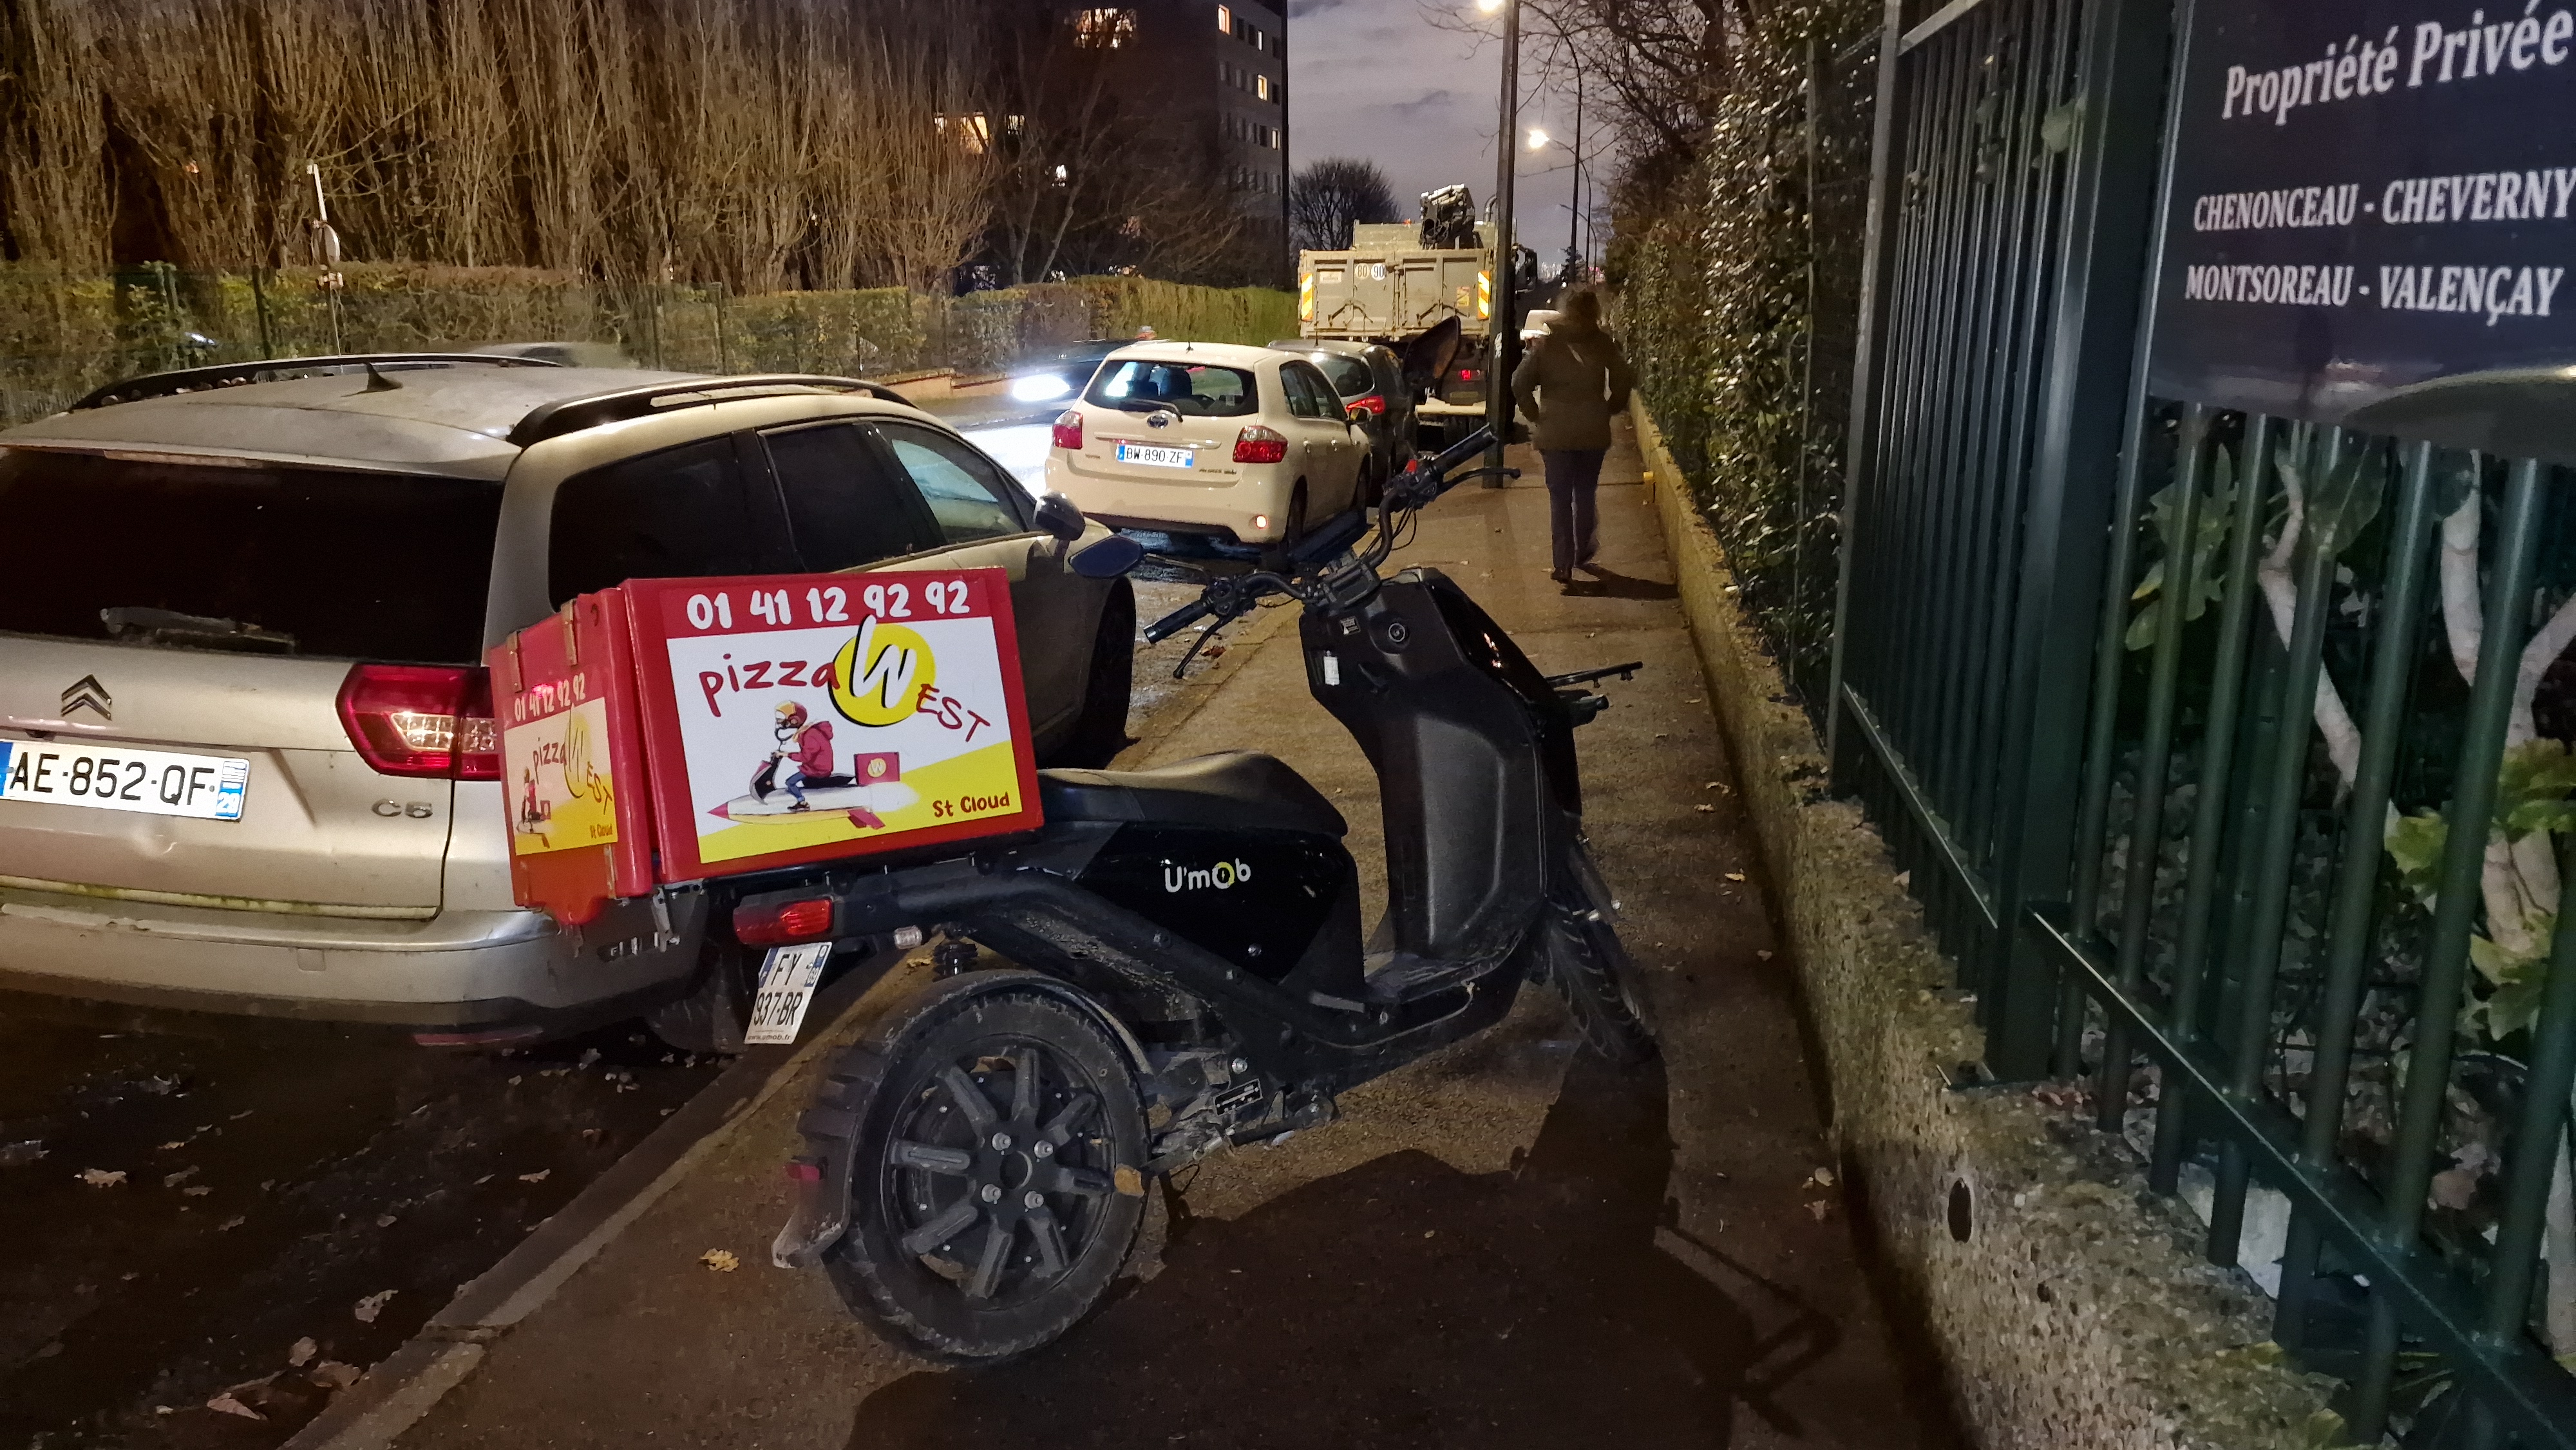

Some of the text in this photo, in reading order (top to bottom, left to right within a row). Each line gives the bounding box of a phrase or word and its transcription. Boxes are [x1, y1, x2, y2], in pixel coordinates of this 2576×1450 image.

[2222, 0, 2575, 126] Propriété Privée
[2194, 184, 2360, 231] CHENONCEAU
[2382, 167, 2576, 224] CHEVERNY
[1358, 265, 1367, 277] 80
[1374, 265, 1384, 278] 90
[2185, 265, 2354, 306] MONTSOREAU
[2380, 265, 2565, 326] VALENÇAY
[687, 580, 971, 630] 01 41 12 92 92
[515, 696, 526, 721] 01
[557, 680, 571, 708] 92
[573, 672, 585, 701] 92
[699, 654, 840, 717] pizza
[533, 737, 567, 785] pizza
[372, 799, 433, 818] C5
[933, 791, 1010, 818] St Cloud
